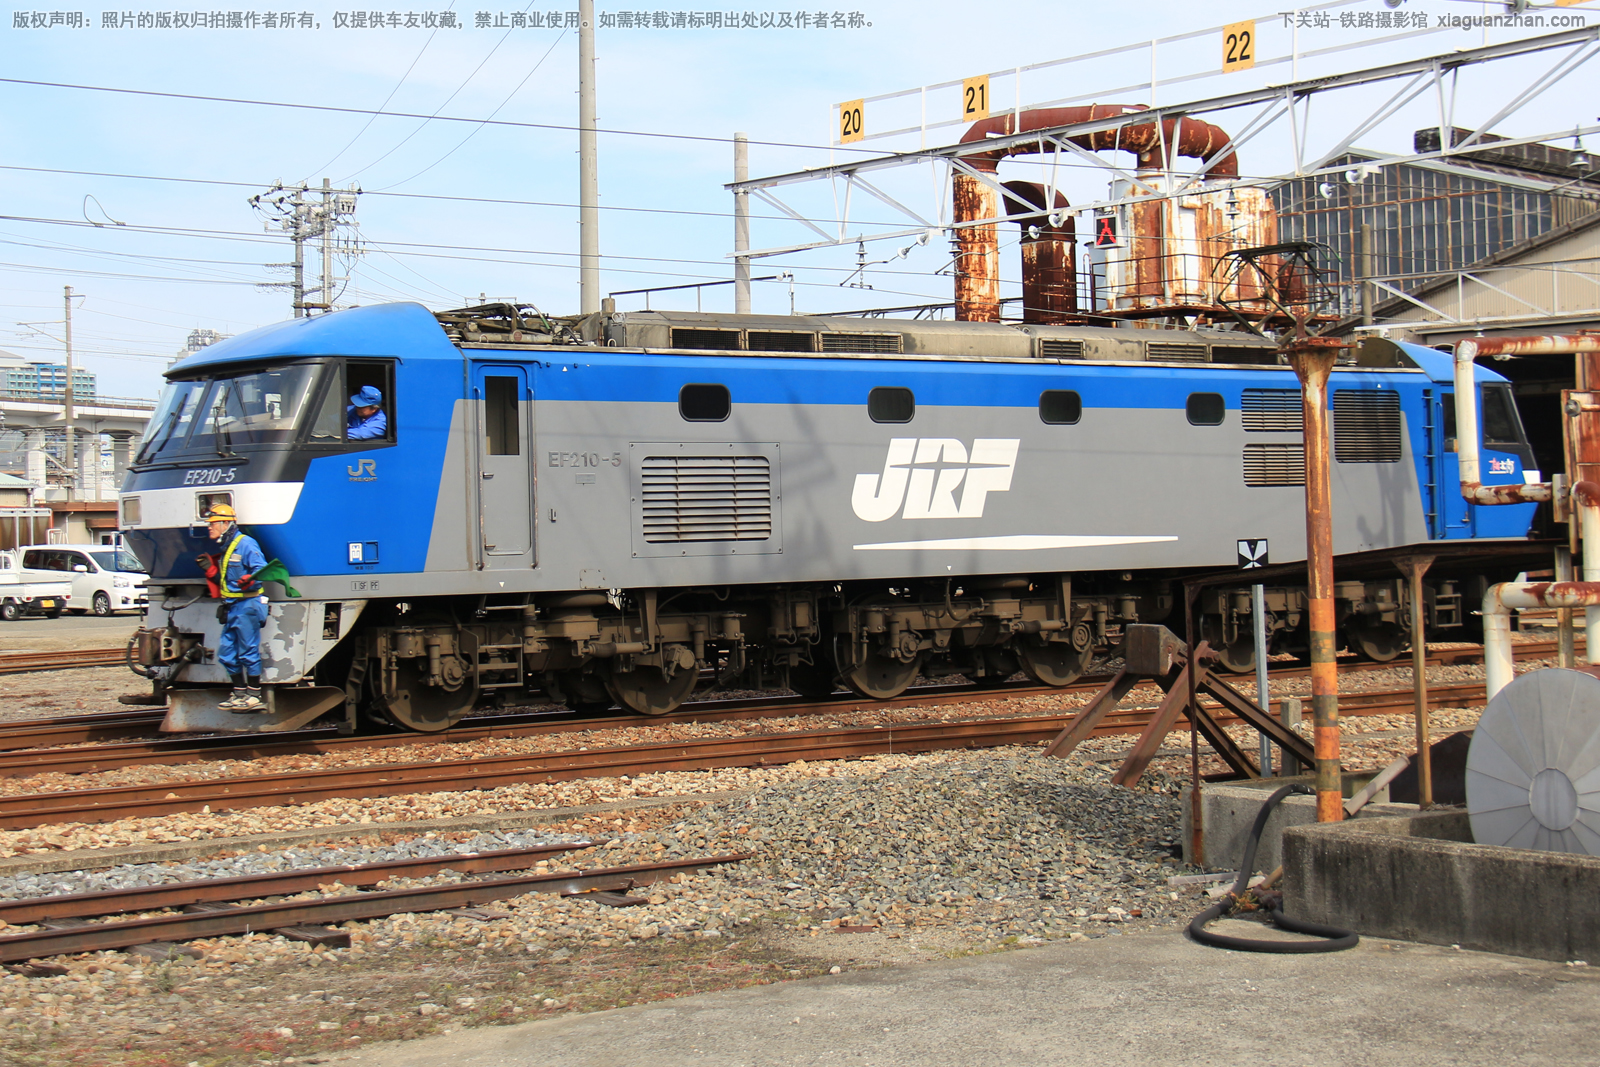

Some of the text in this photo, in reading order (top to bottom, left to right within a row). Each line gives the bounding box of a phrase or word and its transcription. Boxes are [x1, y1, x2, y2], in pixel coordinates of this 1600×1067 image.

[1225, 30, 1251, 64] 22
[965, 84, 986, 114] 21
[842, 108, 861, 137] 20
[347, 458, 377, 477] JR
[548, 451, 622, 468] EF210-5
[183, 467, 237, 485] EF210-5
